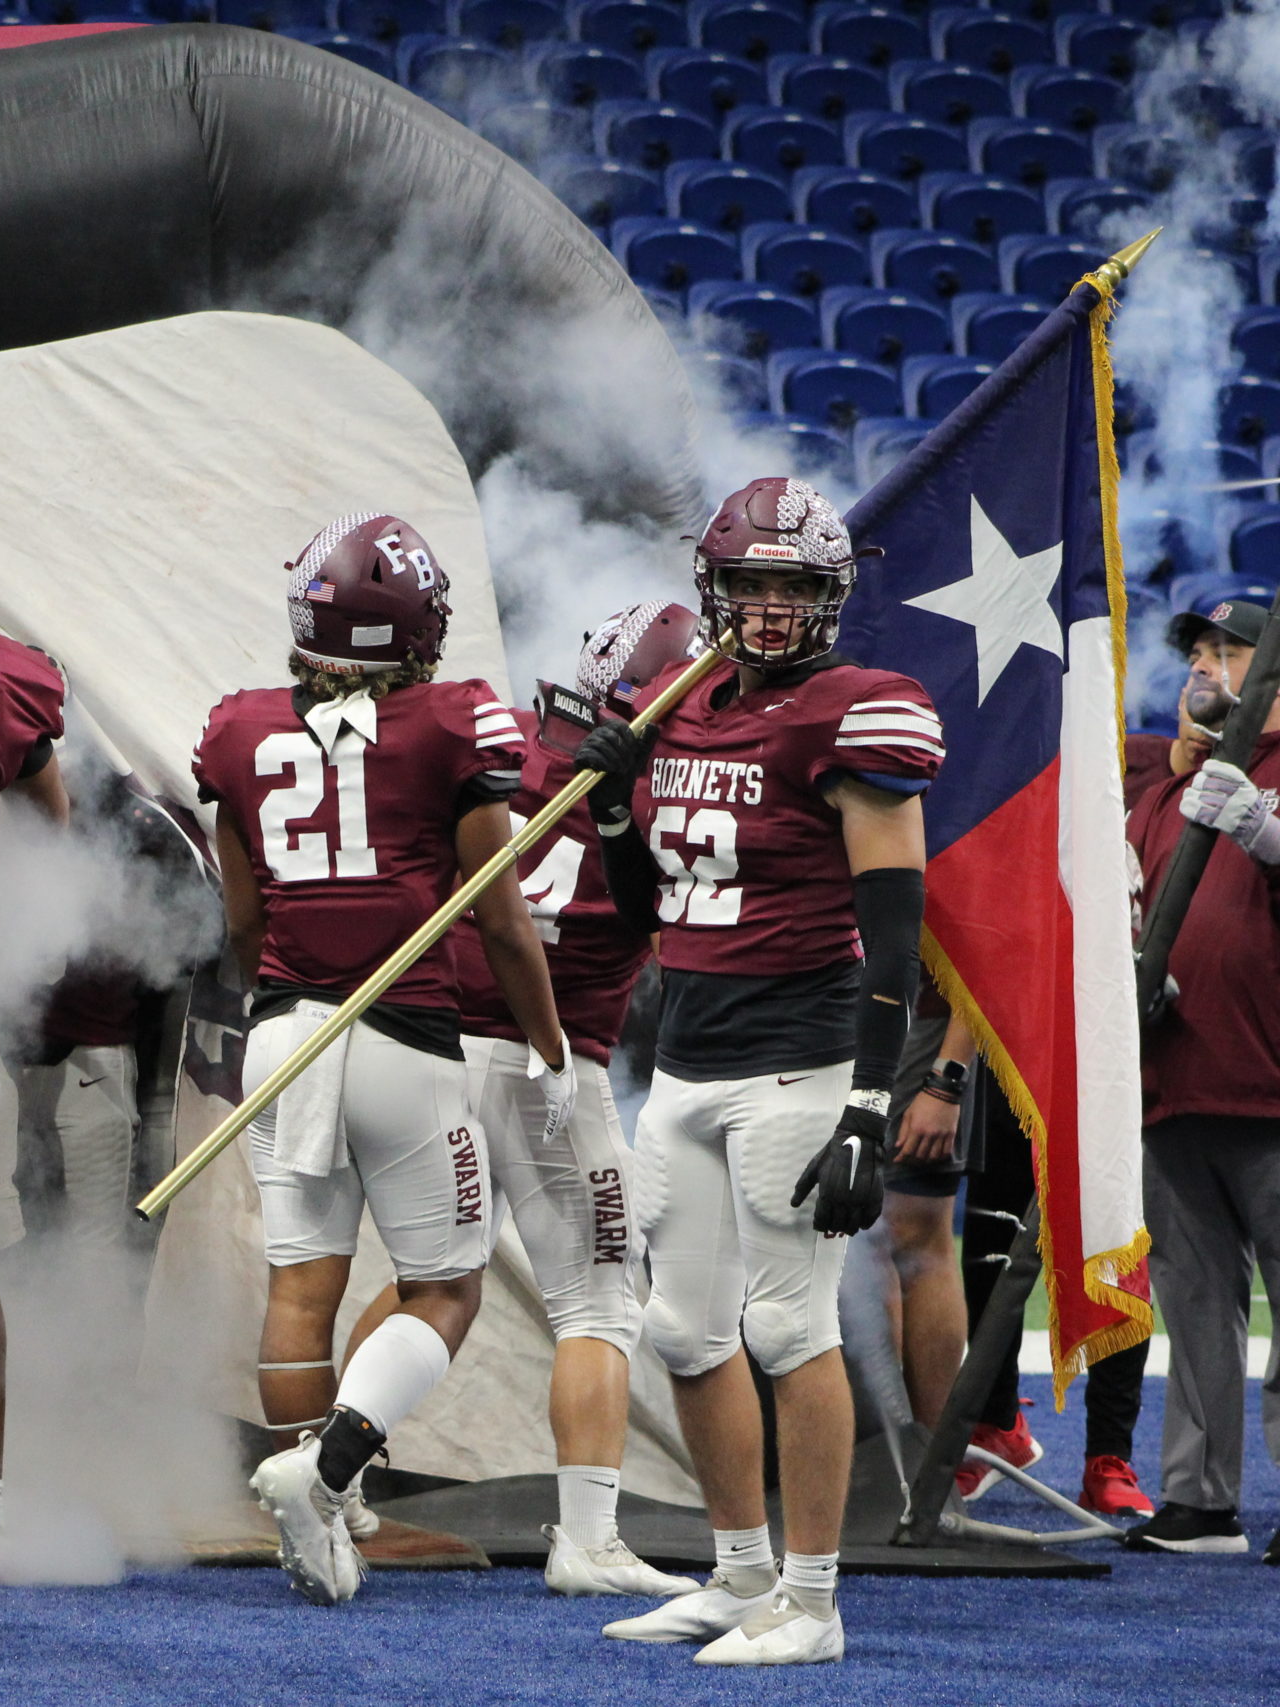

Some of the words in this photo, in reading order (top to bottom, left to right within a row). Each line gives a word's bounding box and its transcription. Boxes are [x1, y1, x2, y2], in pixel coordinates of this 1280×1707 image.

[554, 692, 593, 723] DOUGLAS
[255, 731, 377, 882] 21
[651, 757, 764, 805] HORNETS
[649, 806, 744, 925] 52
[447, 1126, 482, 1226] SWARM
[589, 1167, 627, 1265] SWARM
